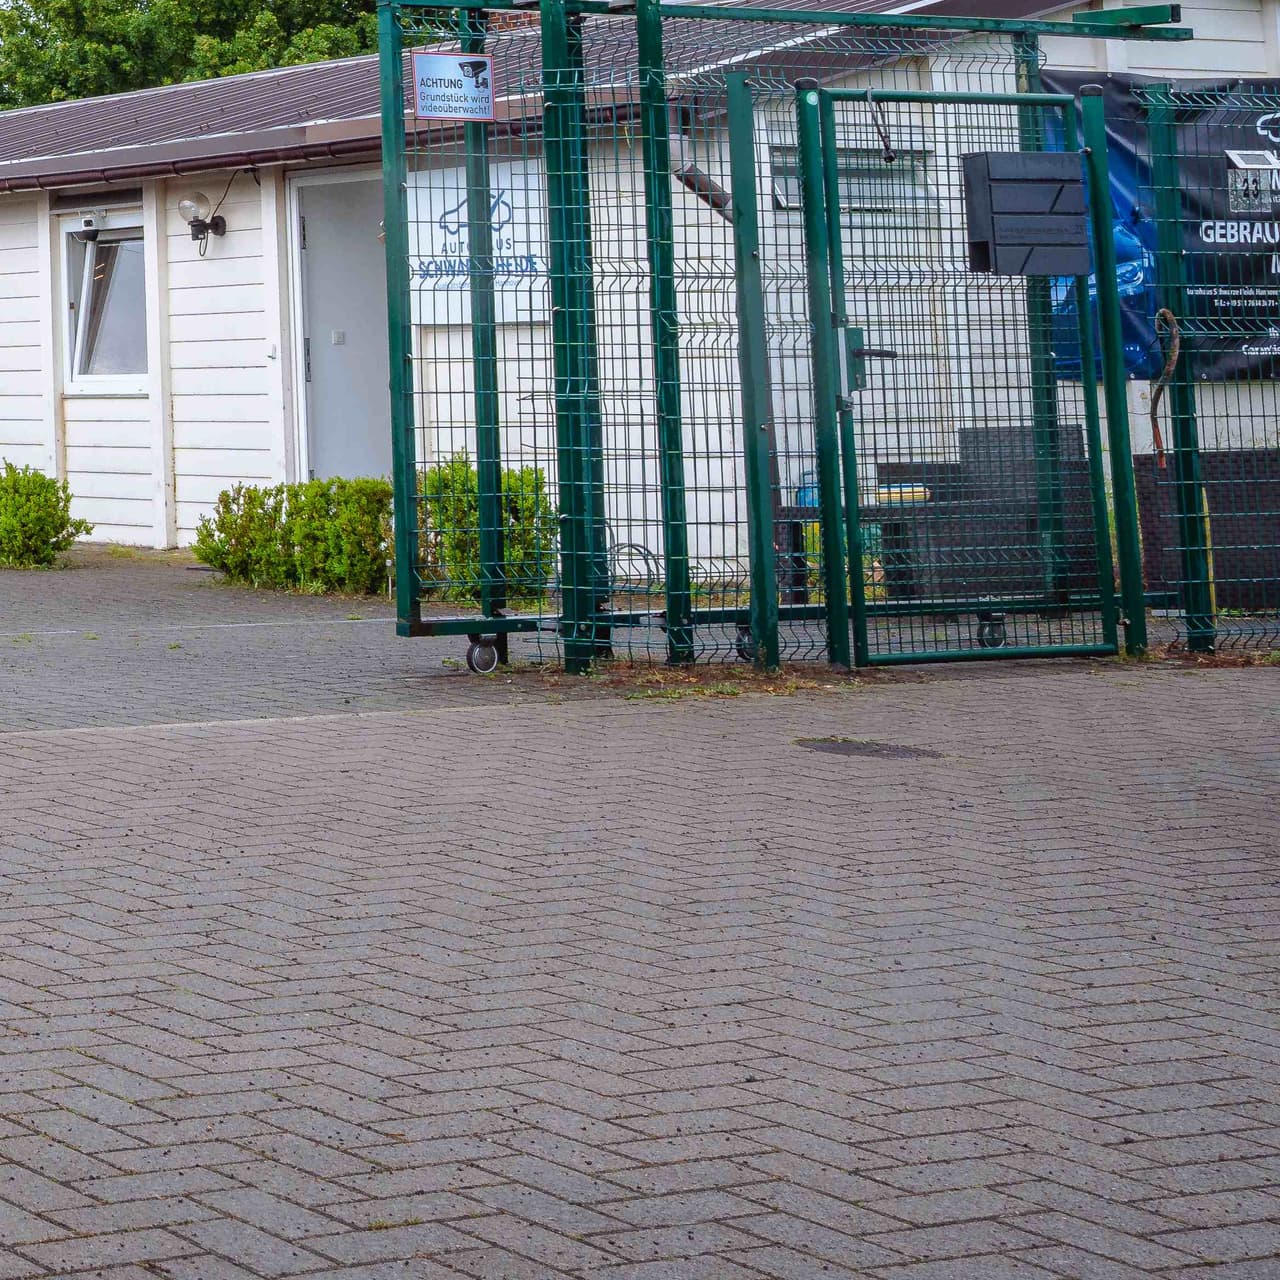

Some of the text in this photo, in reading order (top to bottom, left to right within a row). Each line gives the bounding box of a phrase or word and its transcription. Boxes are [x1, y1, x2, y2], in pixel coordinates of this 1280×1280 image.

[419, 77, 463, 89] ACHTUNG
[420, 91, 490, 104] Grundstück wird
[421, 103, 490, 115] videoüberwacht!
[1242, 178, 1259, 198] 23
